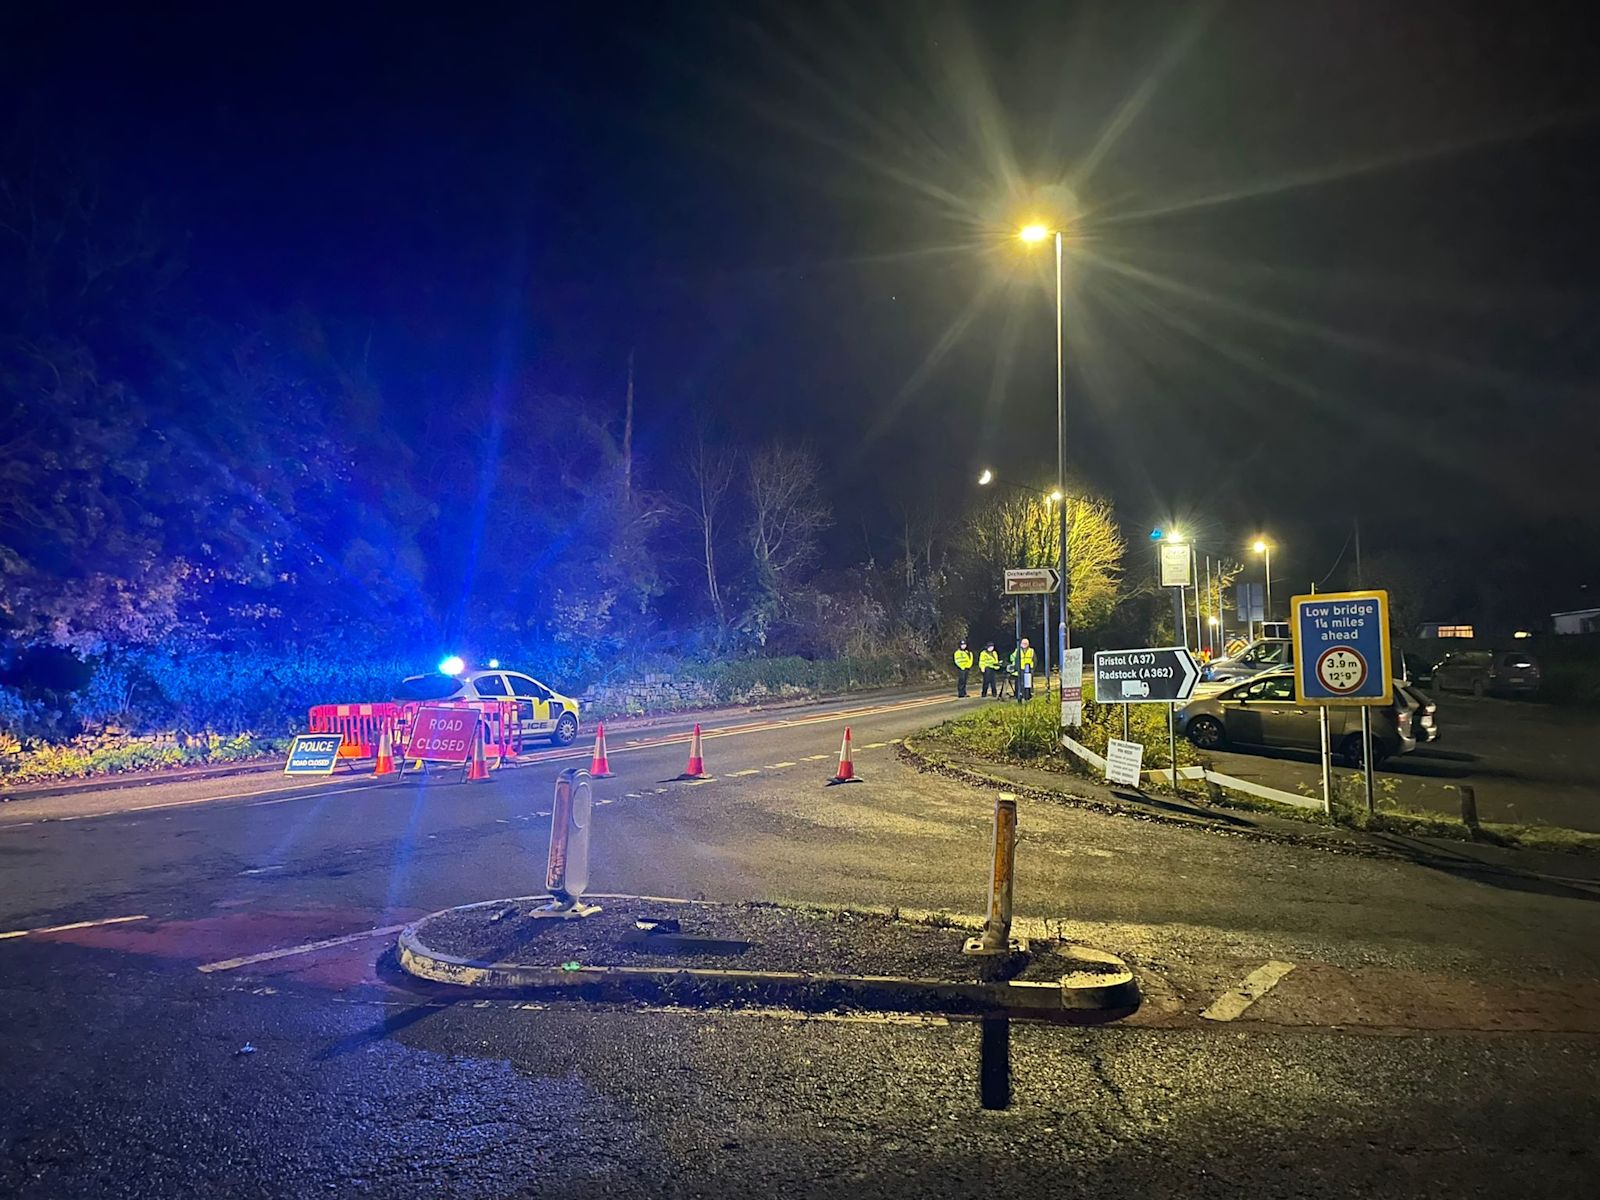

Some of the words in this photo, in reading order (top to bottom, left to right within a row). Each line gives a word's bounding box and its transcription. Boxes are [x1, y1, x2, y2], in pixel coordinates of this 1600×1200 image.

[1305, 607, 1329, 617] Low
[1333, 604, 1373, 616] bridge
[1332, 617, 1364, 627] miles
[1321, 629, 1358, 640] ahead
[1099, 656, 1126, 666] Bristol
[1128, 653, 1155, 665] (A37)
[1099, 669, 1137, 679] Radstock
[1139, 667, 1174, 679] (A362)
[429, 719, 463, 731] ROAD
[298, 741, 334, 752] POLICE
[416, 738, 464, 751] CLOSED
[292, 759, 307, 767] ROAD
